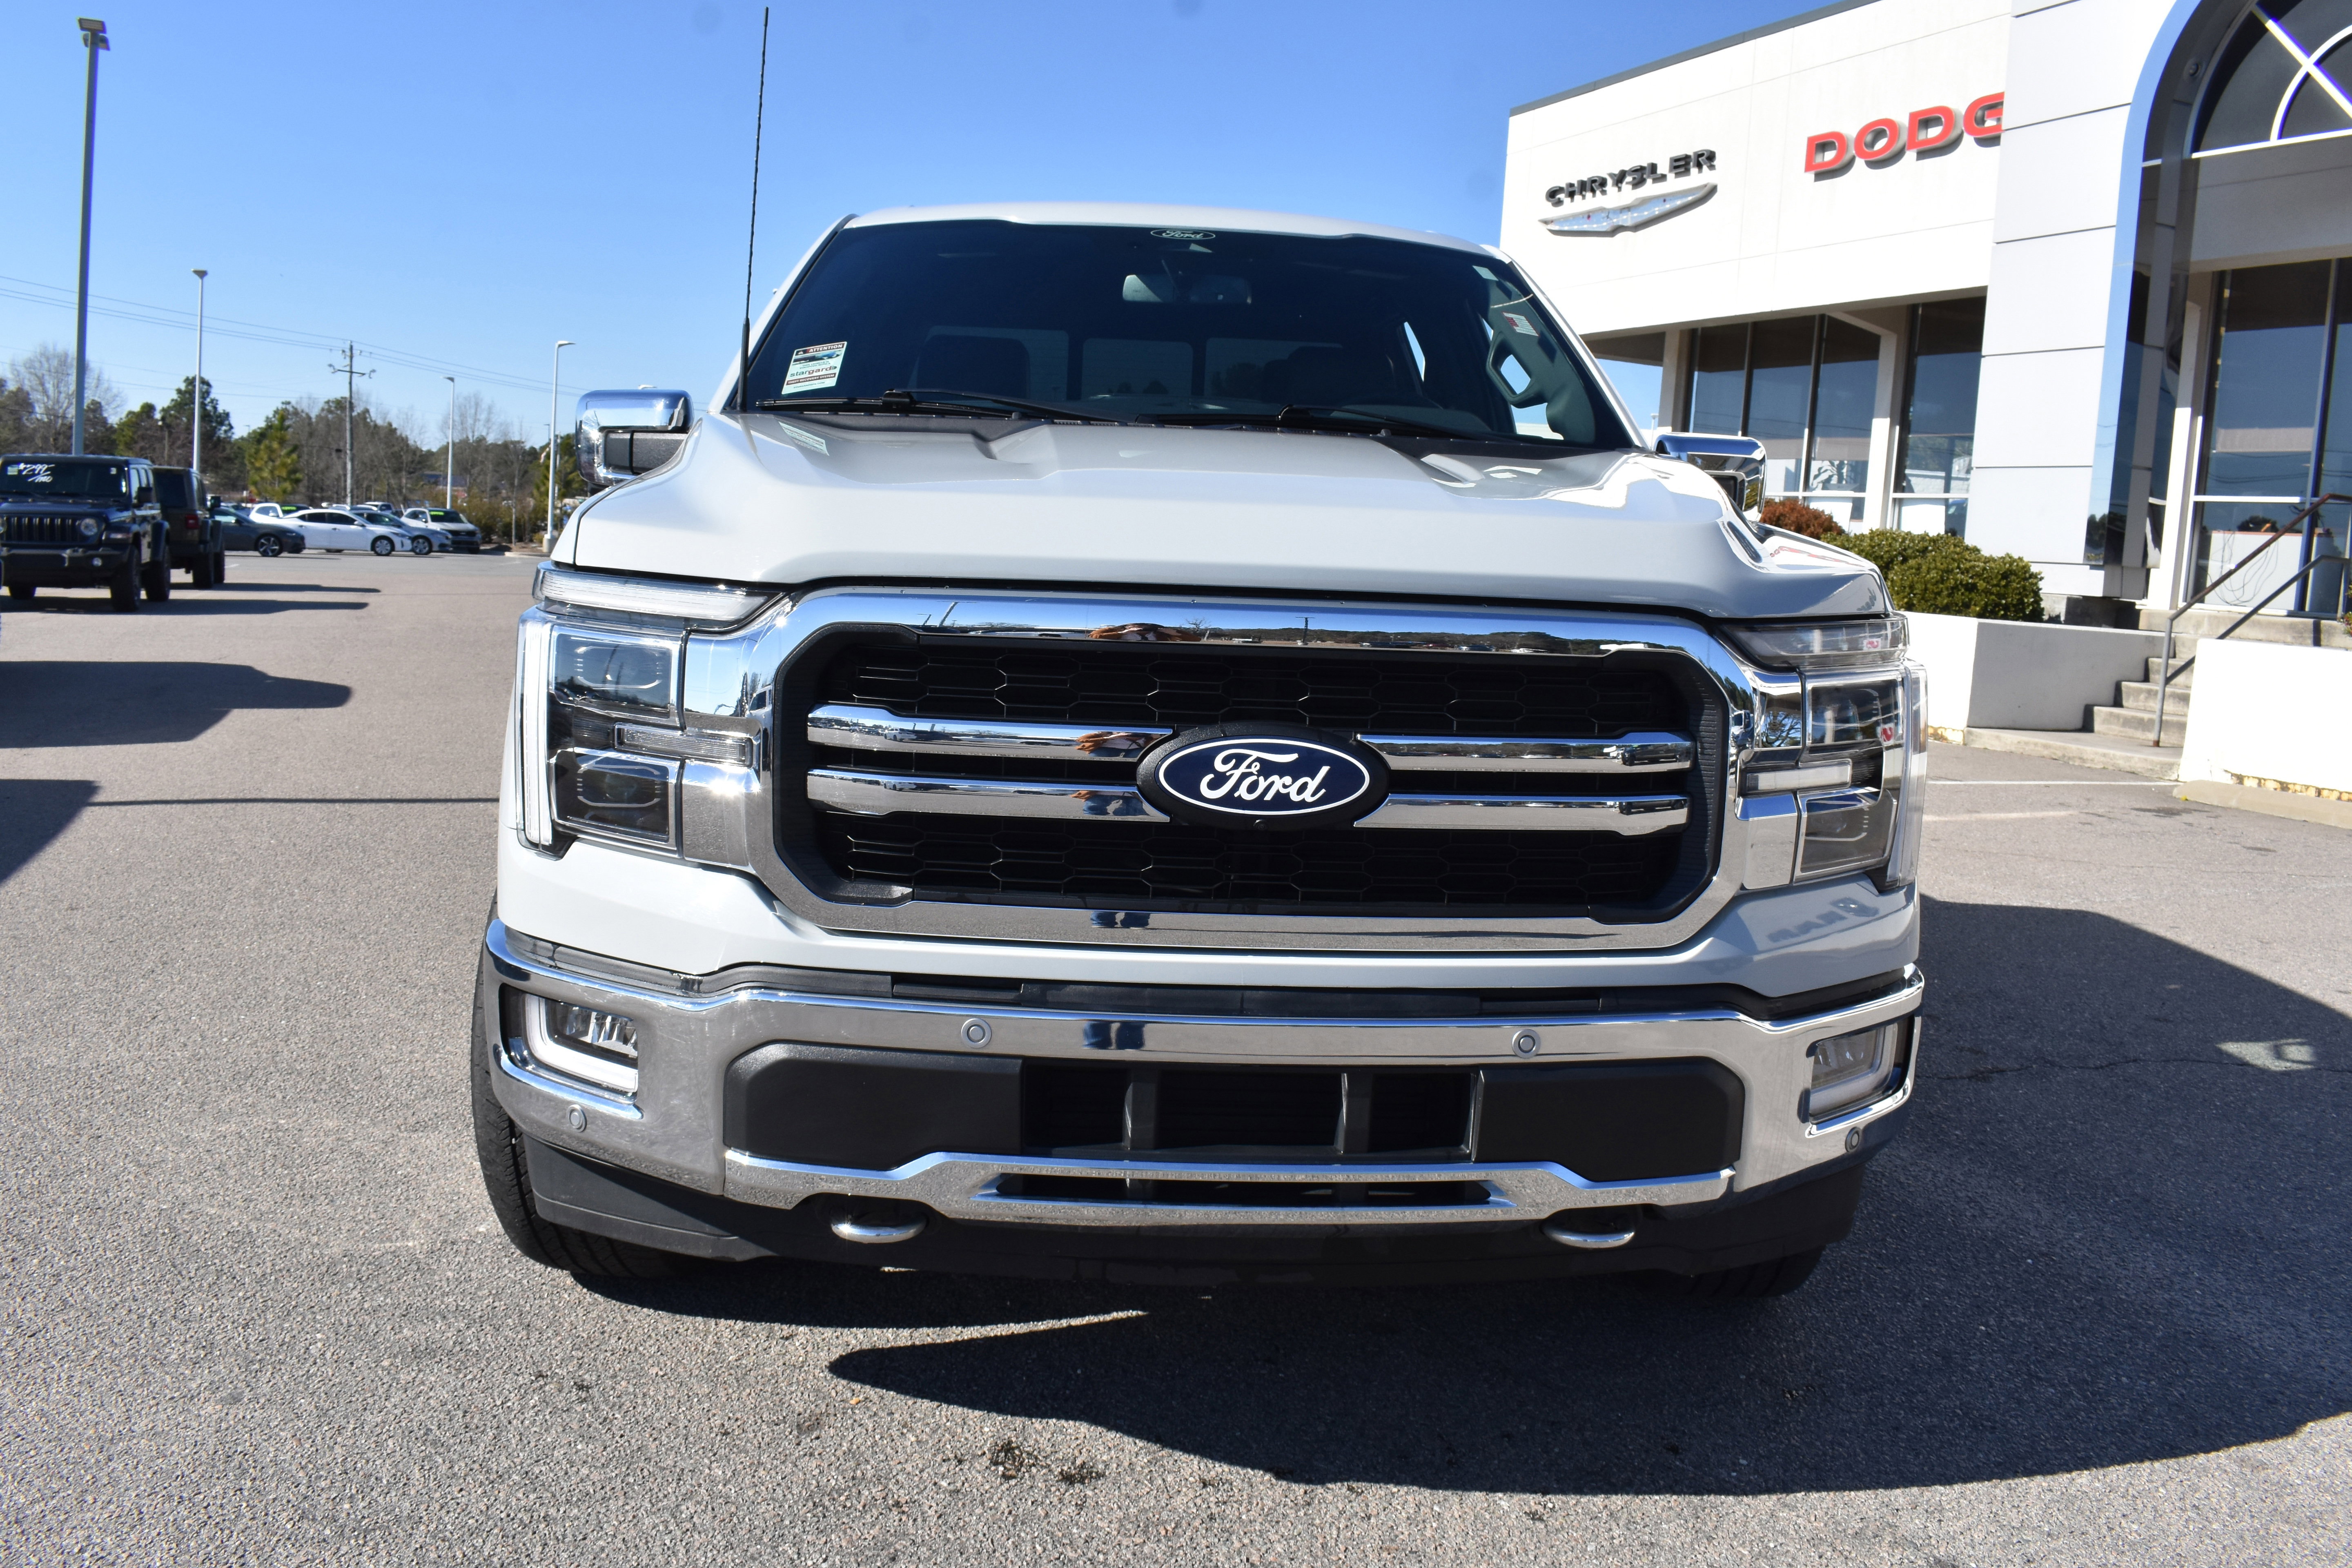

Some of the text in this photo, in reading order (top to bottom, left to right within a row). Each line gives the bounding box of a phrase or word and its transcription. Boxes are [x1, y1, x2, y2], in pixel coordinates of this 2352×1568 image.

[1546, 149, 1716, 206] CHRYSLER
[809, 344, 842, 352] ATTENTION
[790, 366, 832, 377] stargard
[1200, 749, 1330, 802] Ford
